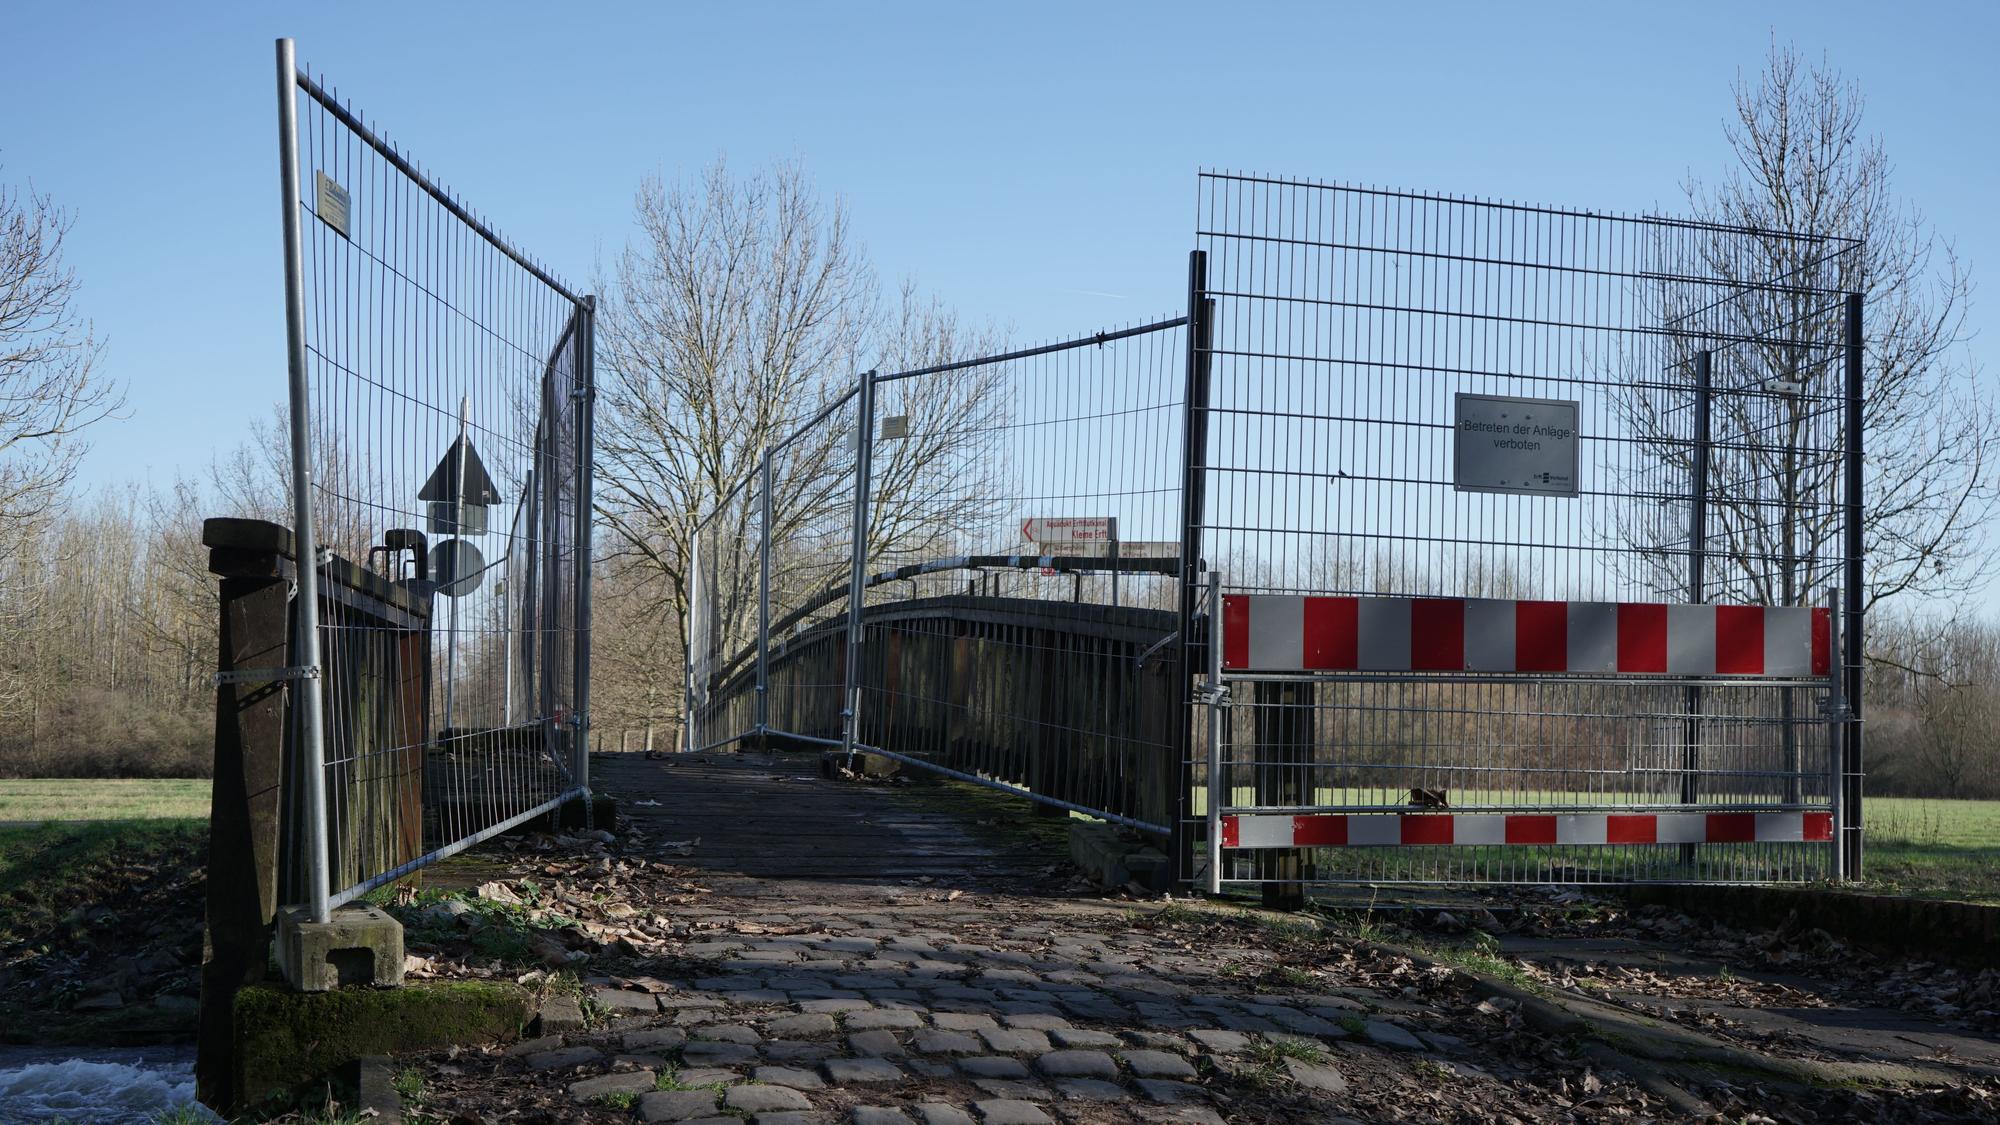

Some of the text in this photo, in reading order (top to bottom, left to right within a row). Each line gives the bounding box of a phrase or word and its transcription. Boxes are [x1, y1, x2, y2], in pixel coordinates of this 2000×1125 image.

[1464, 420, 1570, 440] Betreten der Anlage
[1494, 439, 1541, 451] verboten
